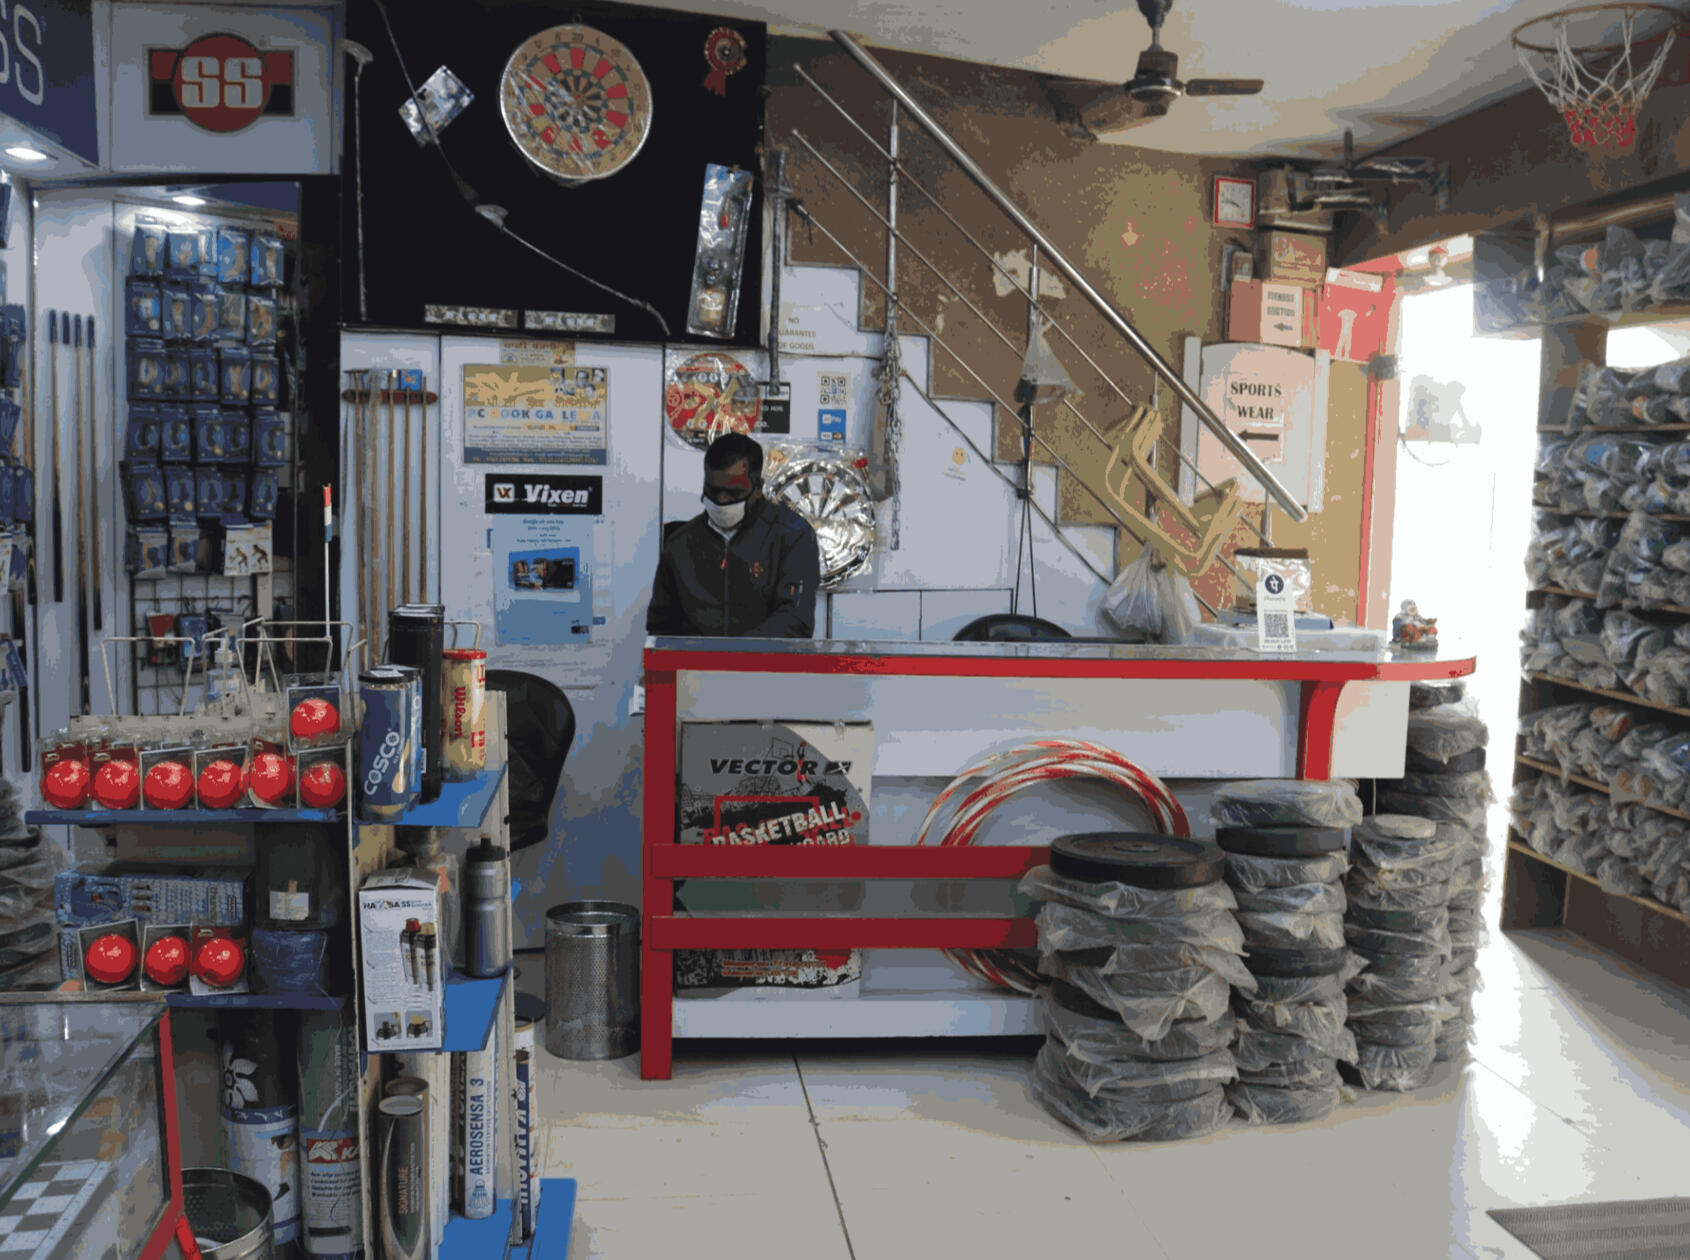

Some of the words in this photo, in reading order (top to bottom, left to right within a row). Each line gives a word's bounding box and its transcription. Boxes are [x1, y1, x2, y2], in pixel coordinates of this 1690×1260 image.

[181, 56, 263, 108] SS
[1230, 381, 1282, 398] SPORTS
[1236, 404, 1274, 420] WEAR
[524, 484, 590, 504] Vixen
[455, 686, 466, 738] Wilson
[363, 731, 400, 796] COSCO
[710, 759, 819, 776] VECTOR
[470, 1078, 484, 1087] 3
[469, 1094, 484, 1176] AEROSENSA
[397, 1167, 409, 1216] SIGNATURE
